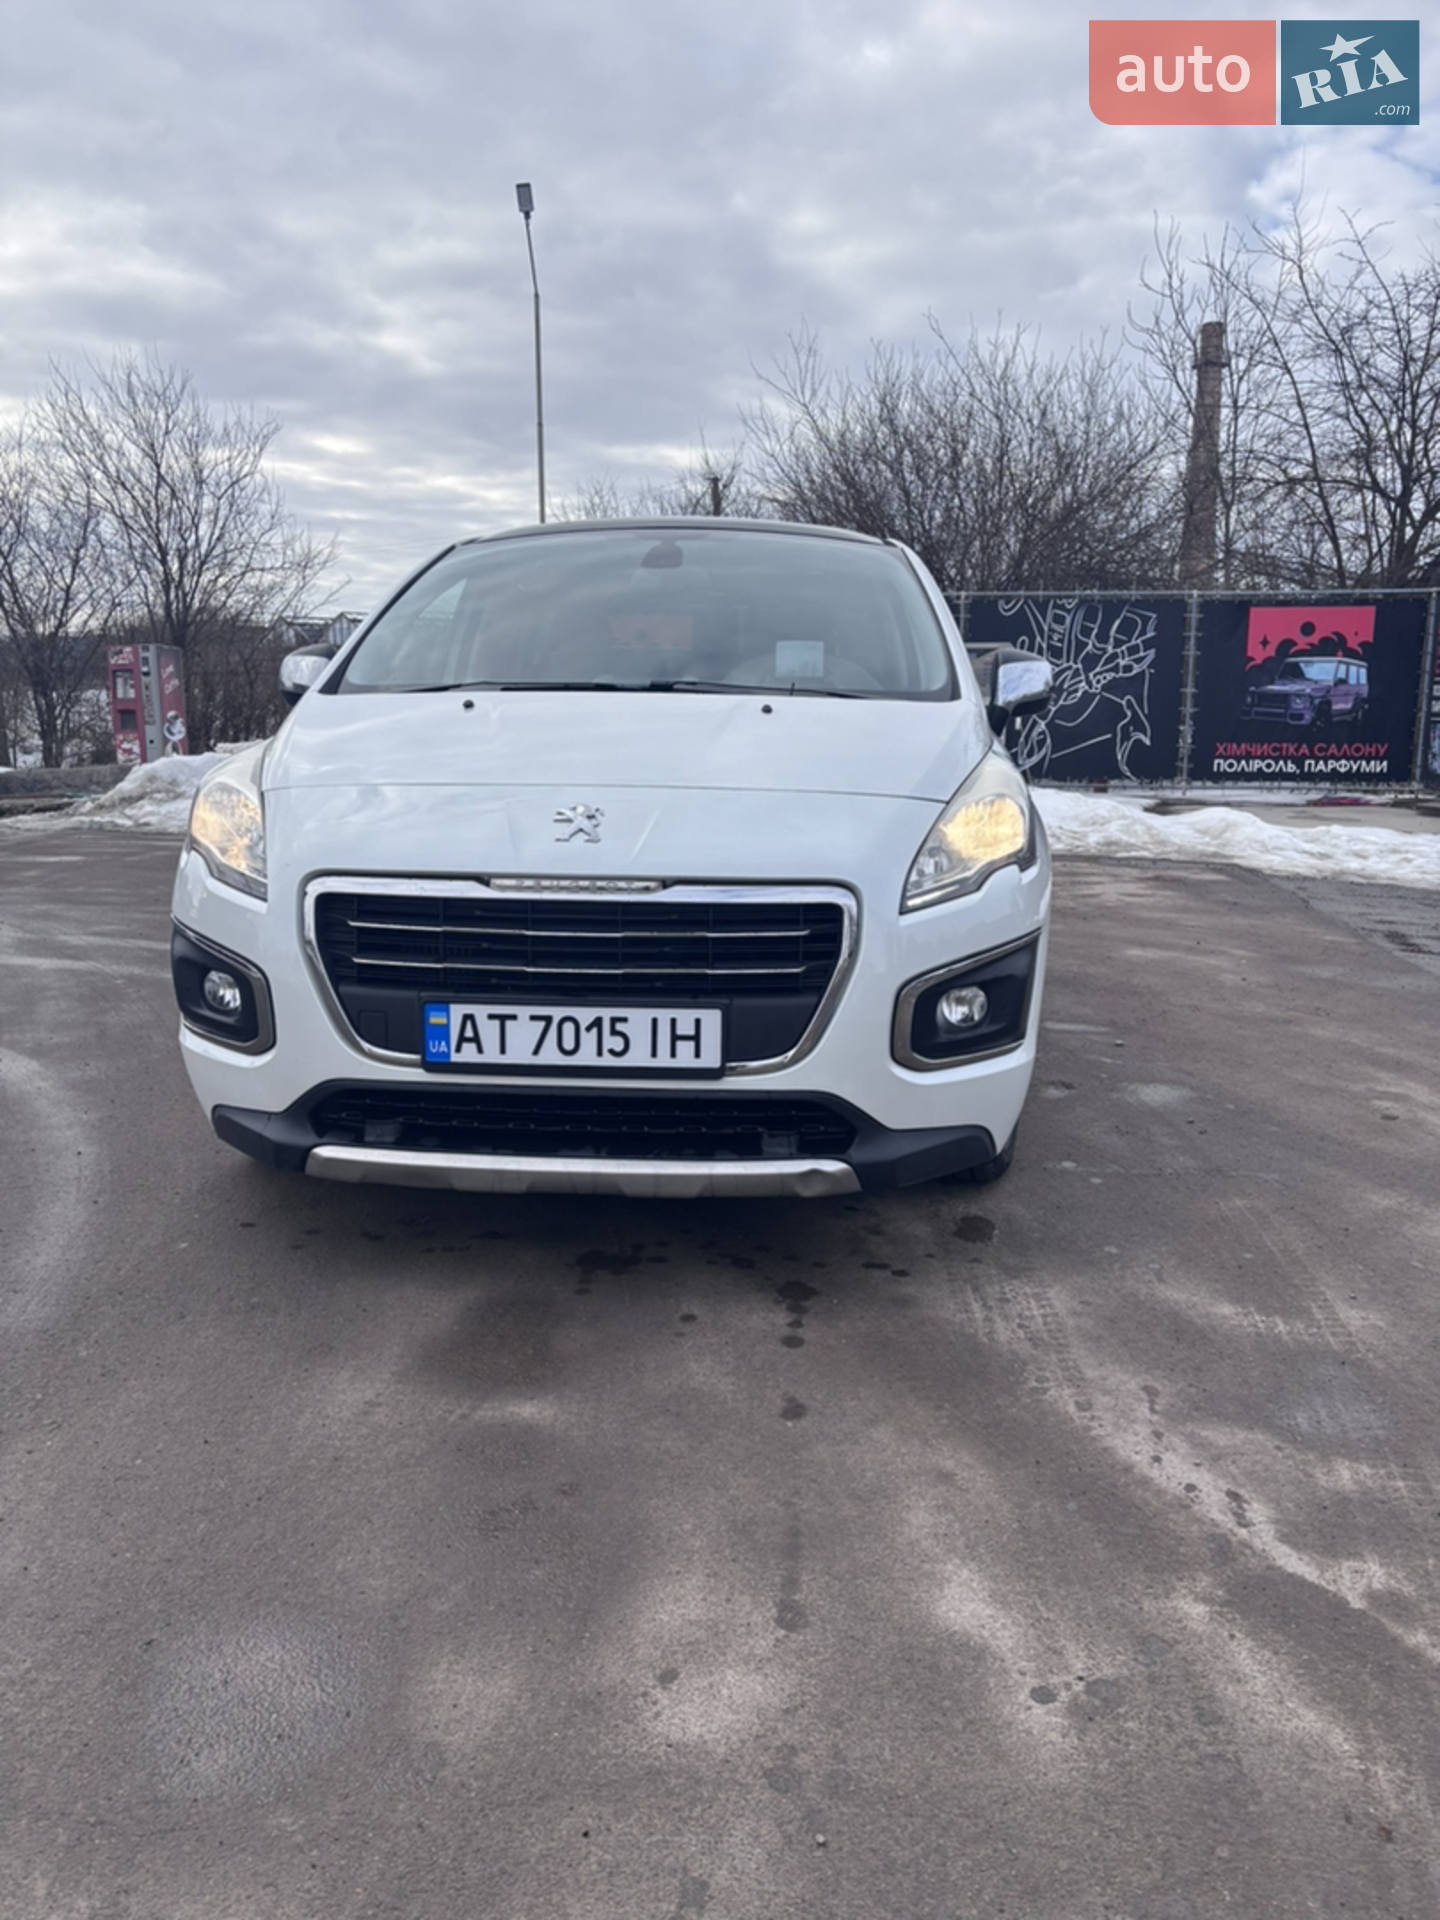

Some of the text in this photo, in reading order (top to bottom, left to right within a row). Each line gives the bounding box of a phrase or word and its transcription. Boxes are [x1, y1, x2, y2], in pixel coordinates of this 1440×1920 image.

[1215, 742, 1388, 757] ХІМЧИСТКА САЛОНУ
[1213, 758, 1388, 774] ПОЛІРОЛЬ, ПАРФУМИ
[454, 1013, 702, 1059] AT 7015 IH
[429, 1039, 449, 1053] UA
